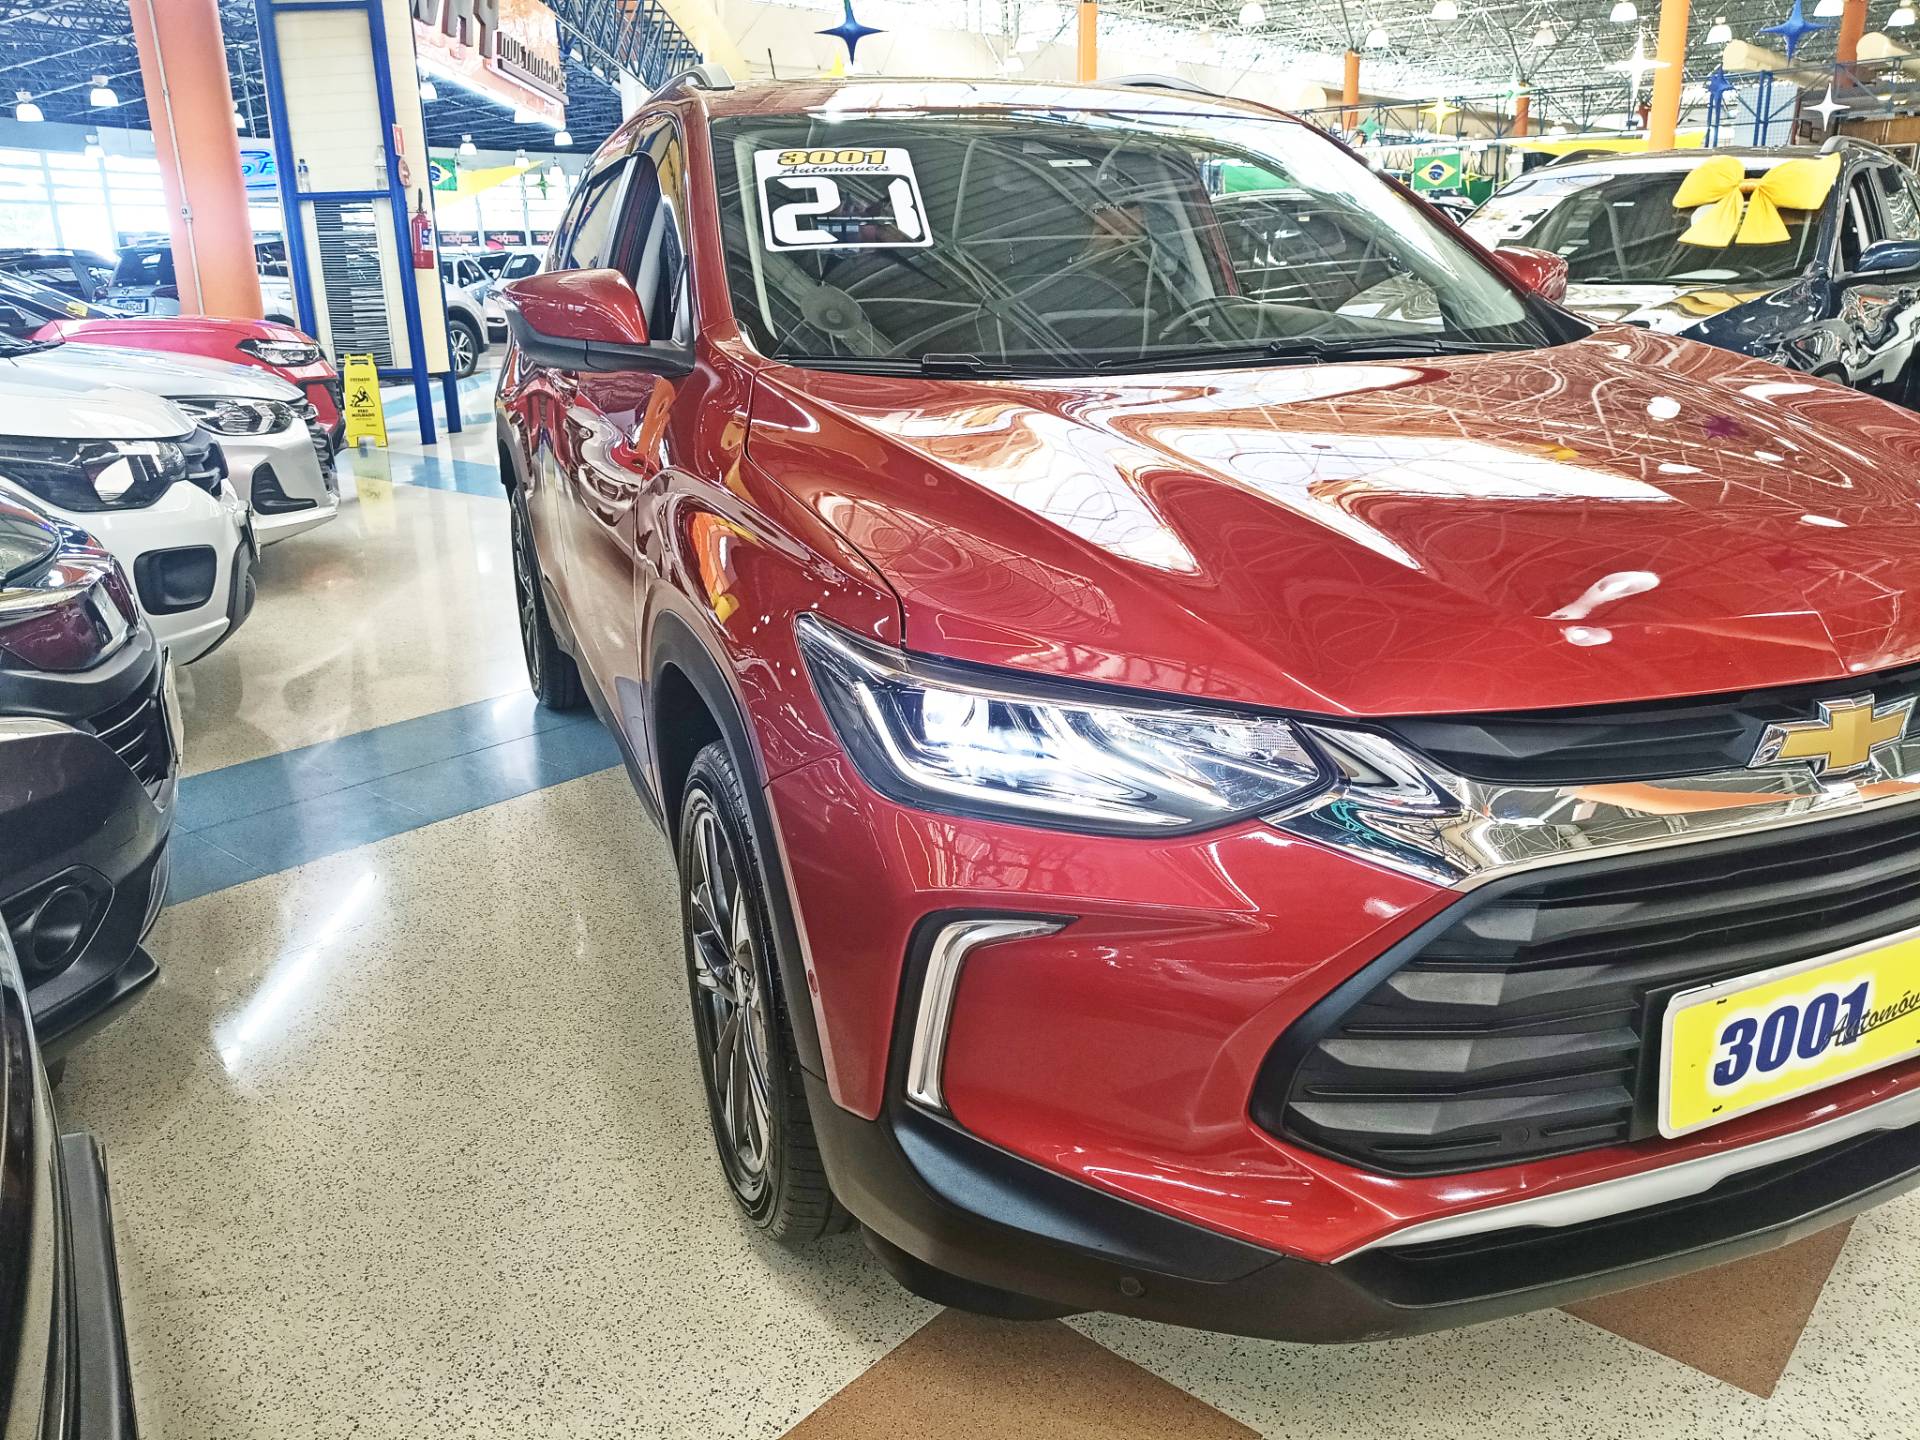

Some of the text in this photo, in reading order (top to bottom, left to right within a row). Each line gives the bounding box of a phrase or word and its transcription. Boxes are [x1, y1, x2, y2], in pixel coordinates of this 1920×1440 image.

[777, 149, 887, 166] 3001
[772, 176, 921, 245] 21
[1713, 981, 1869, 1086] 3001
